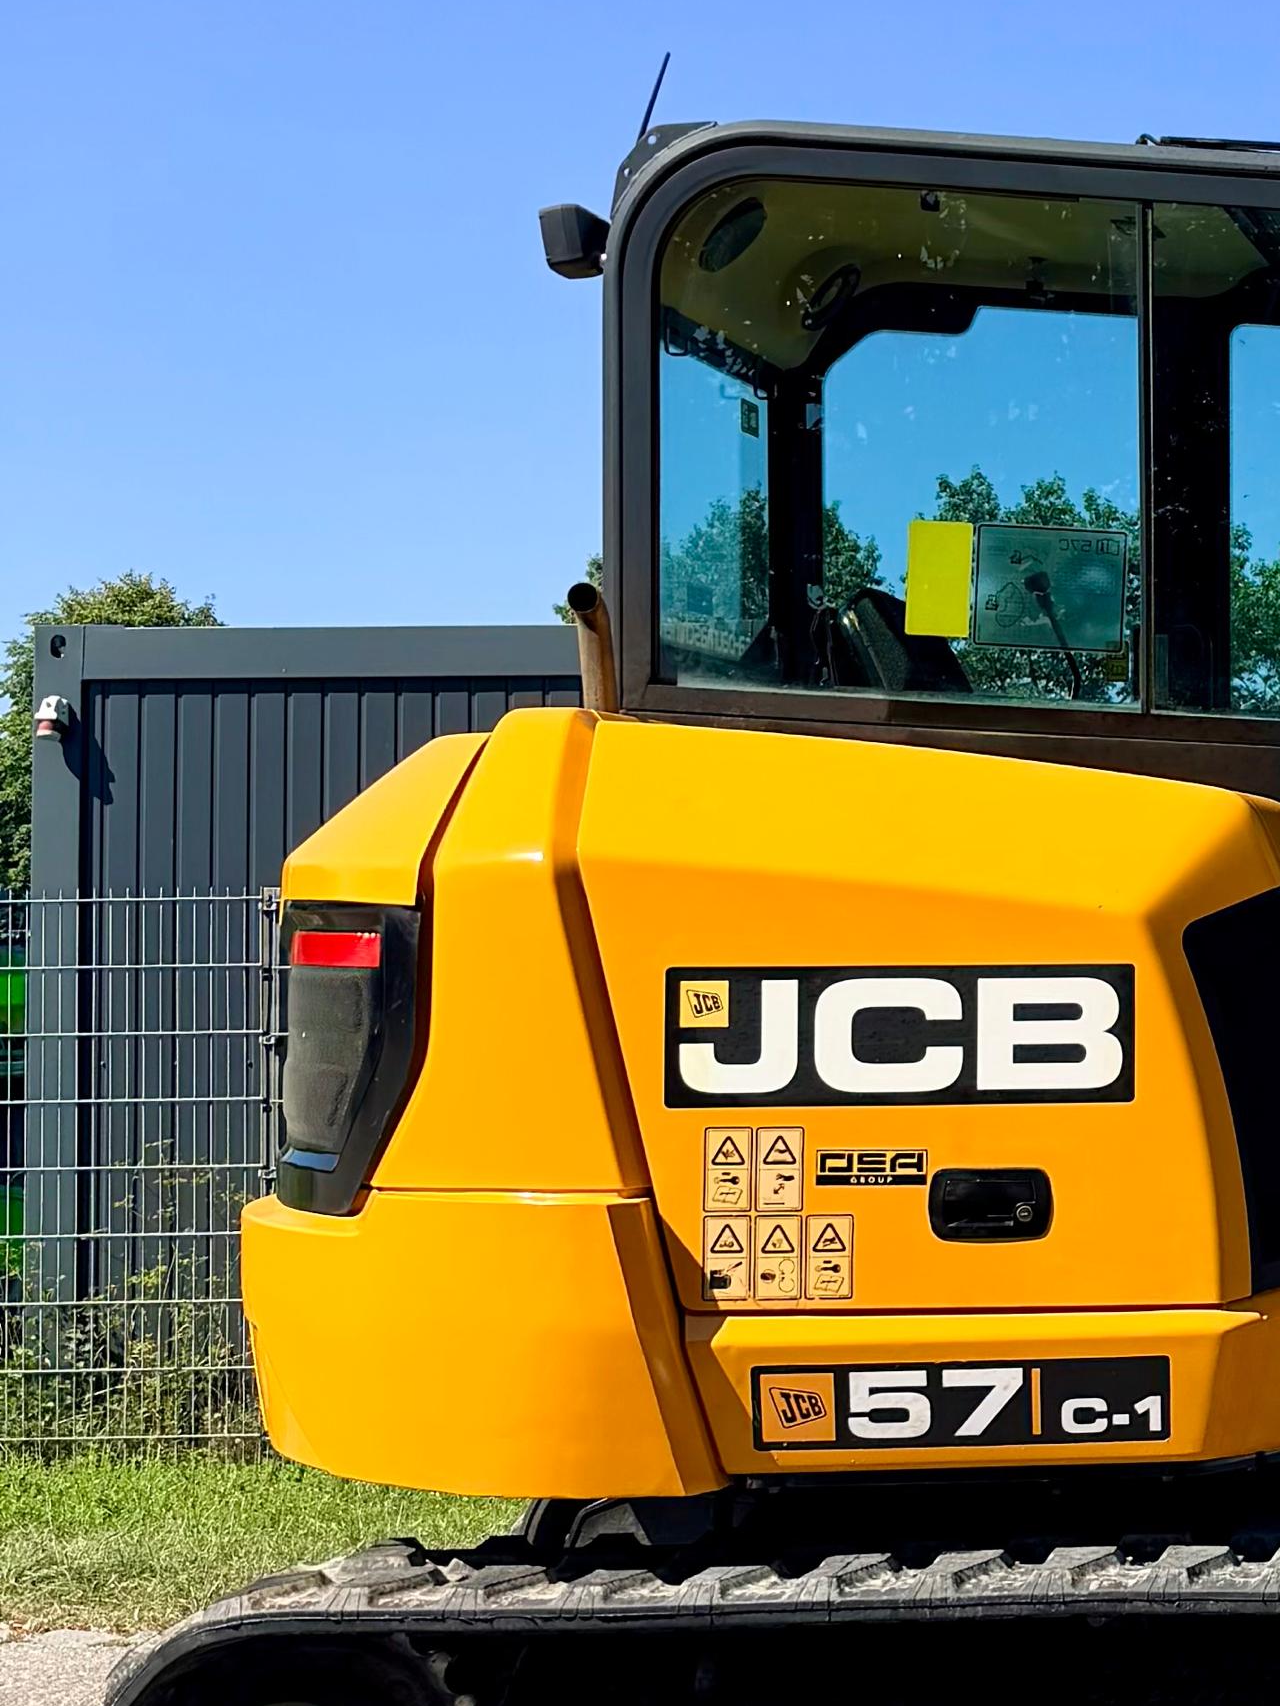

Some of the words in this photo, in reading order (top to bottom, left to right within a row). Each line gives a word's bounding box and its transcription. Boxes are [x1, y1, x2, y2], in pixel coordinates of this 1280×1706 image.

[694, 993, 721, 1014] JCB
[679, 977, 1124, 1094] JCB
[849, 1176, 894, 1184] GROUP
[780, 1391, 823, 1424] JCB
[848, 1367, 1023, 1439] 57
[1061, 1395, 1162, 1434] C-1
